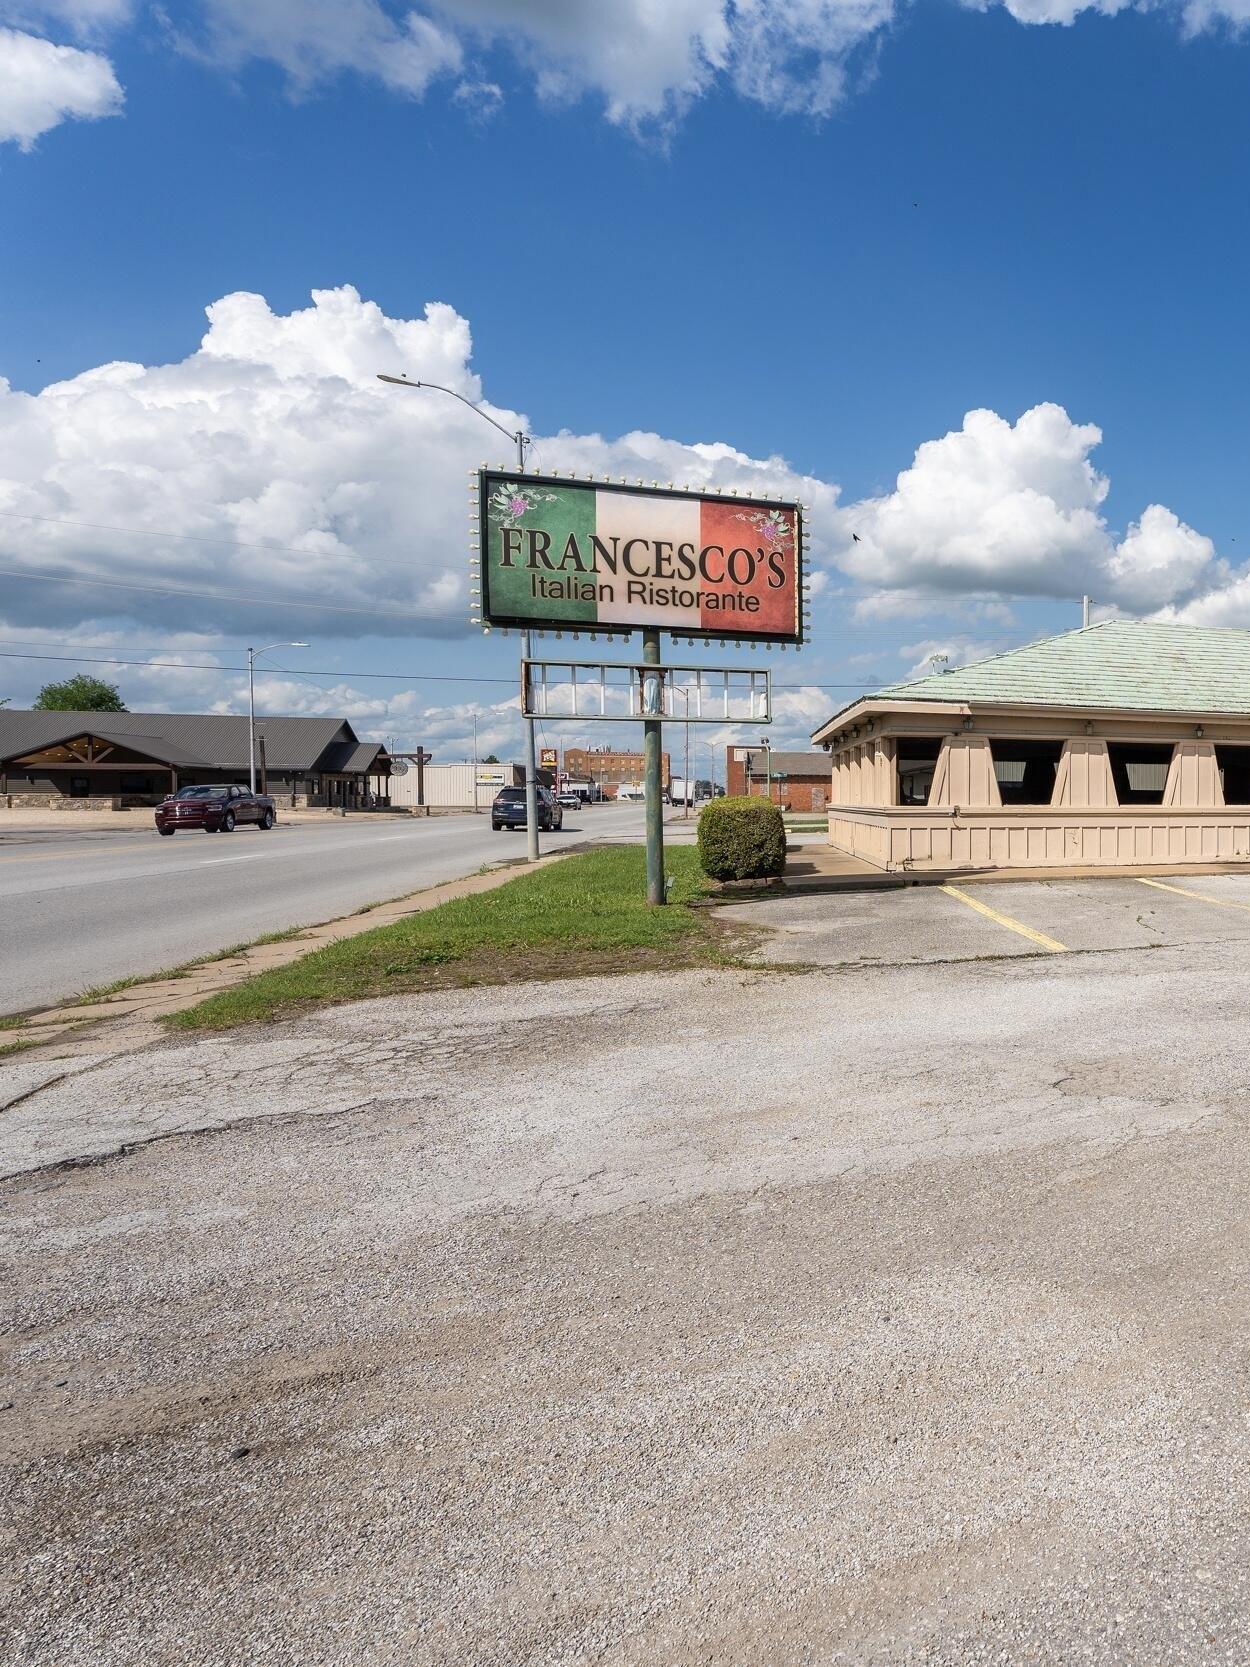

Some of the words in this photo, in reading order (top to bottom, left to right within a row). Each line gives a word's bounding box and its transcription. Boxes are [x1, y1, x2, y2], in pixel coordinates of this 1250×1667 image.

[499, 527, 786, 589] FRANCESCO'S
[531, 573, 614, 603] Italian
[627, 580, 760, 613] Ristorante
